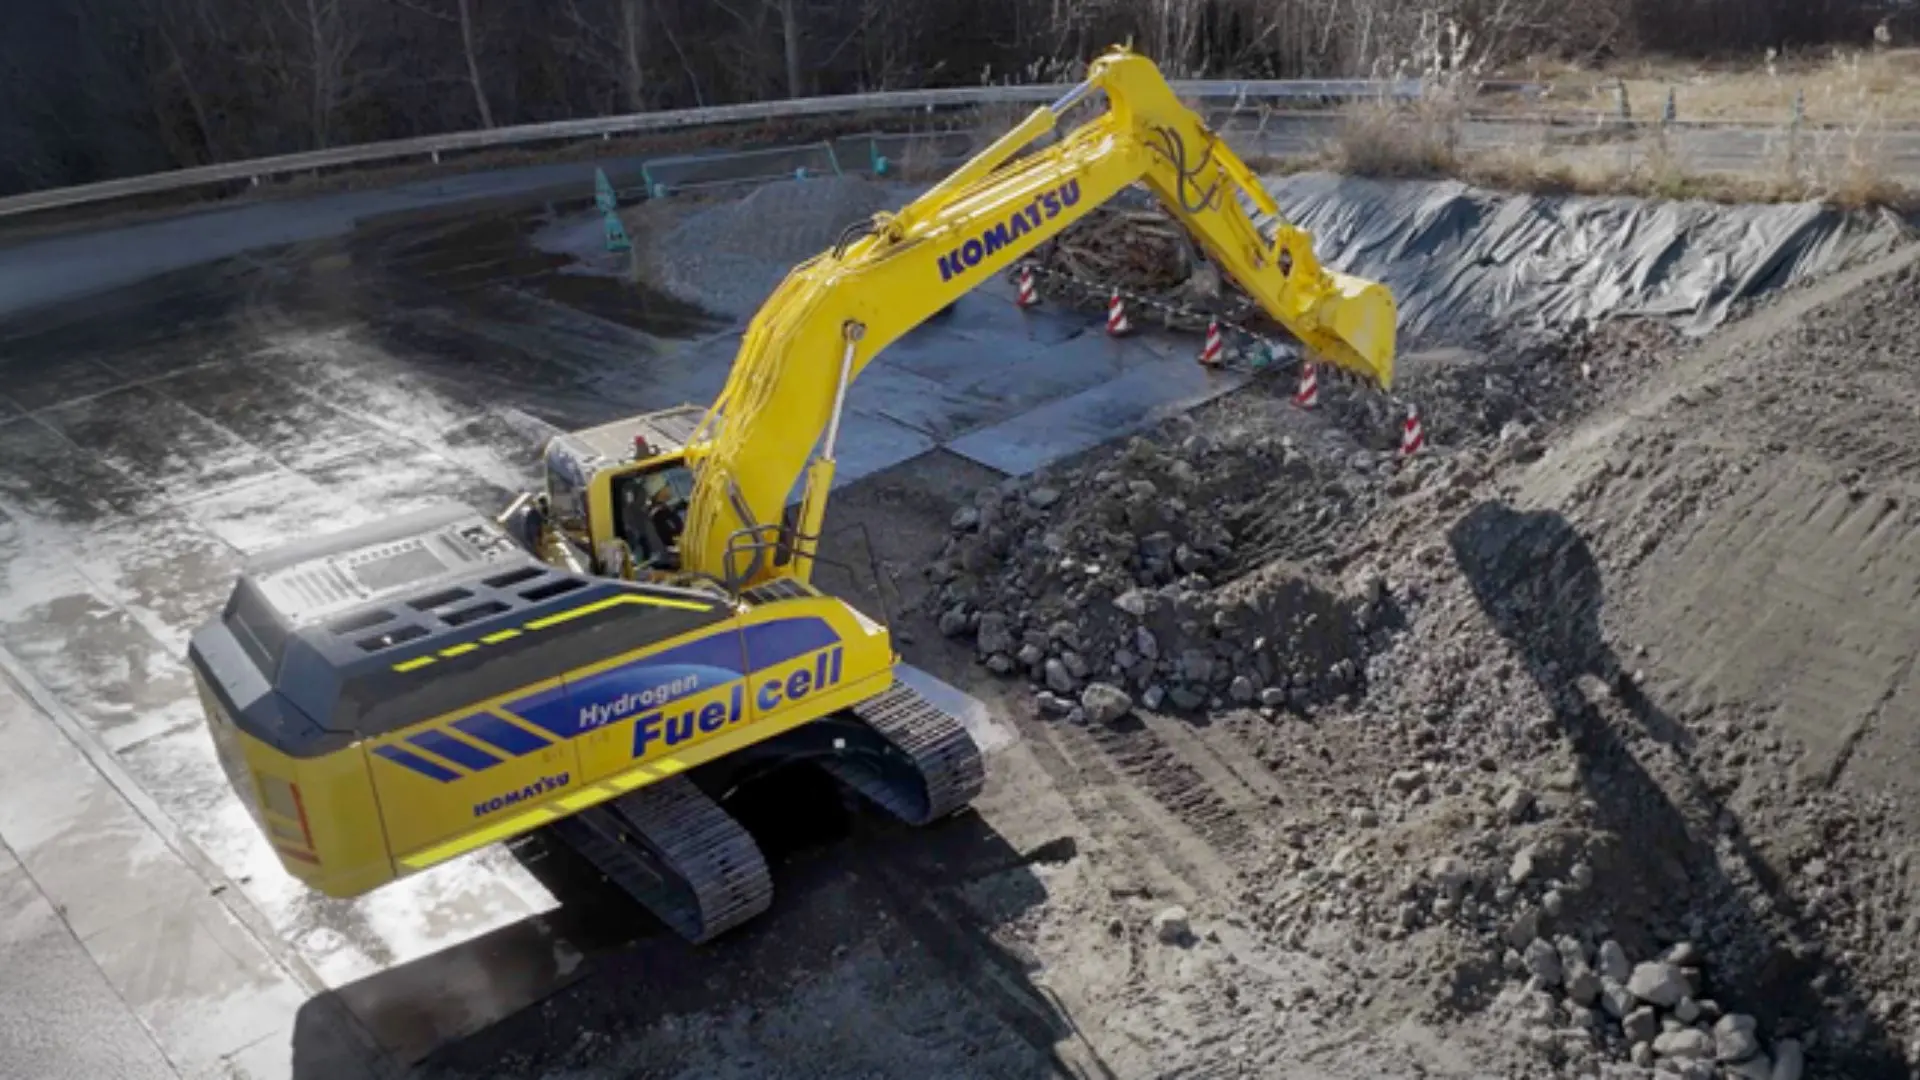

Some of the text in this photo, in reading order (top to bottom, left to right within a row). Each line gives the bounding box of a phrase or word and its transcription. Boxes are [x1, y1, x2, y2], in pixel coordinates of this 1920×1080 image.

[937, 177, 1081, 283] KOMATSU
[578, 672, 698, 729] Hydrogen
[632, 647, 843, 758] Fuel cell
[474, 772, 569, 816] KOMATSU
